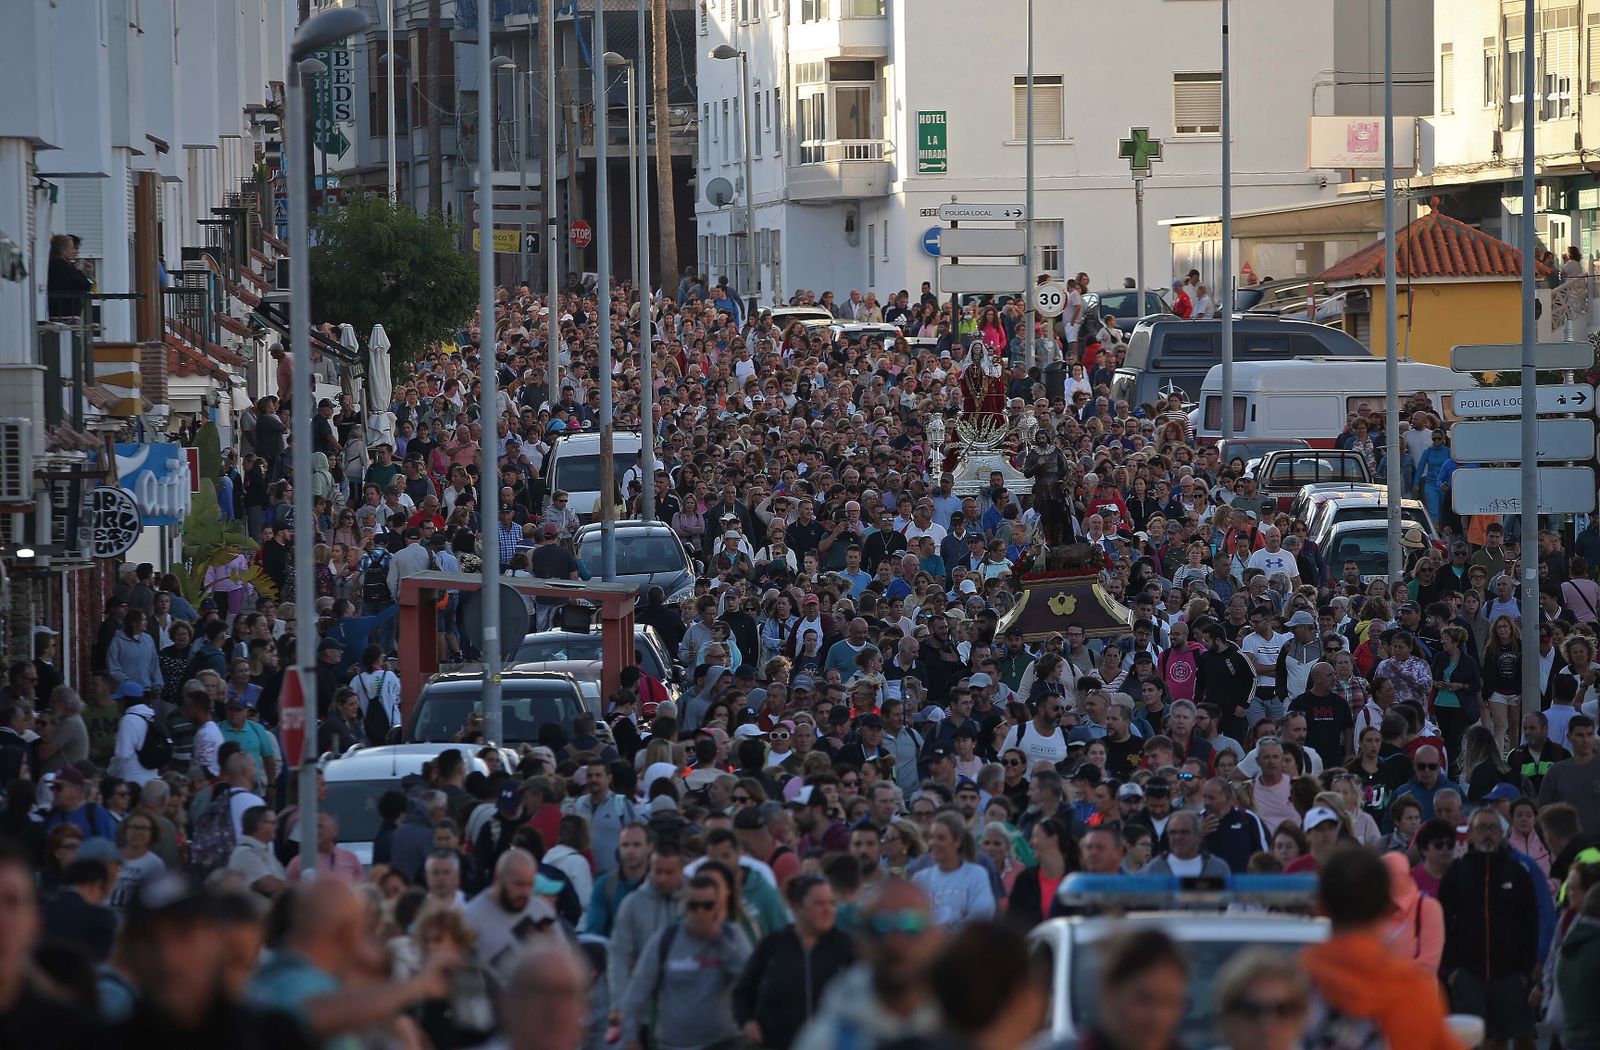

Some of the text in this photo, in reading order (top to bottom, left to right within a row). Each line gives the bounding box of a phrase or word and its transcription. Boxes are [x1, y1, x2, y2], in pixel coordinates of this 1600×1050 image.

[333, 50, 352, 120] BEDS
[919, 114, 946, 124] HOTEL
[927, 135, 938, 145] LA
[571, 228, 591, 239] STOP
[1039, 293, 1061, 306] 30
[1460, 398, 1501, 409] POLICIA
